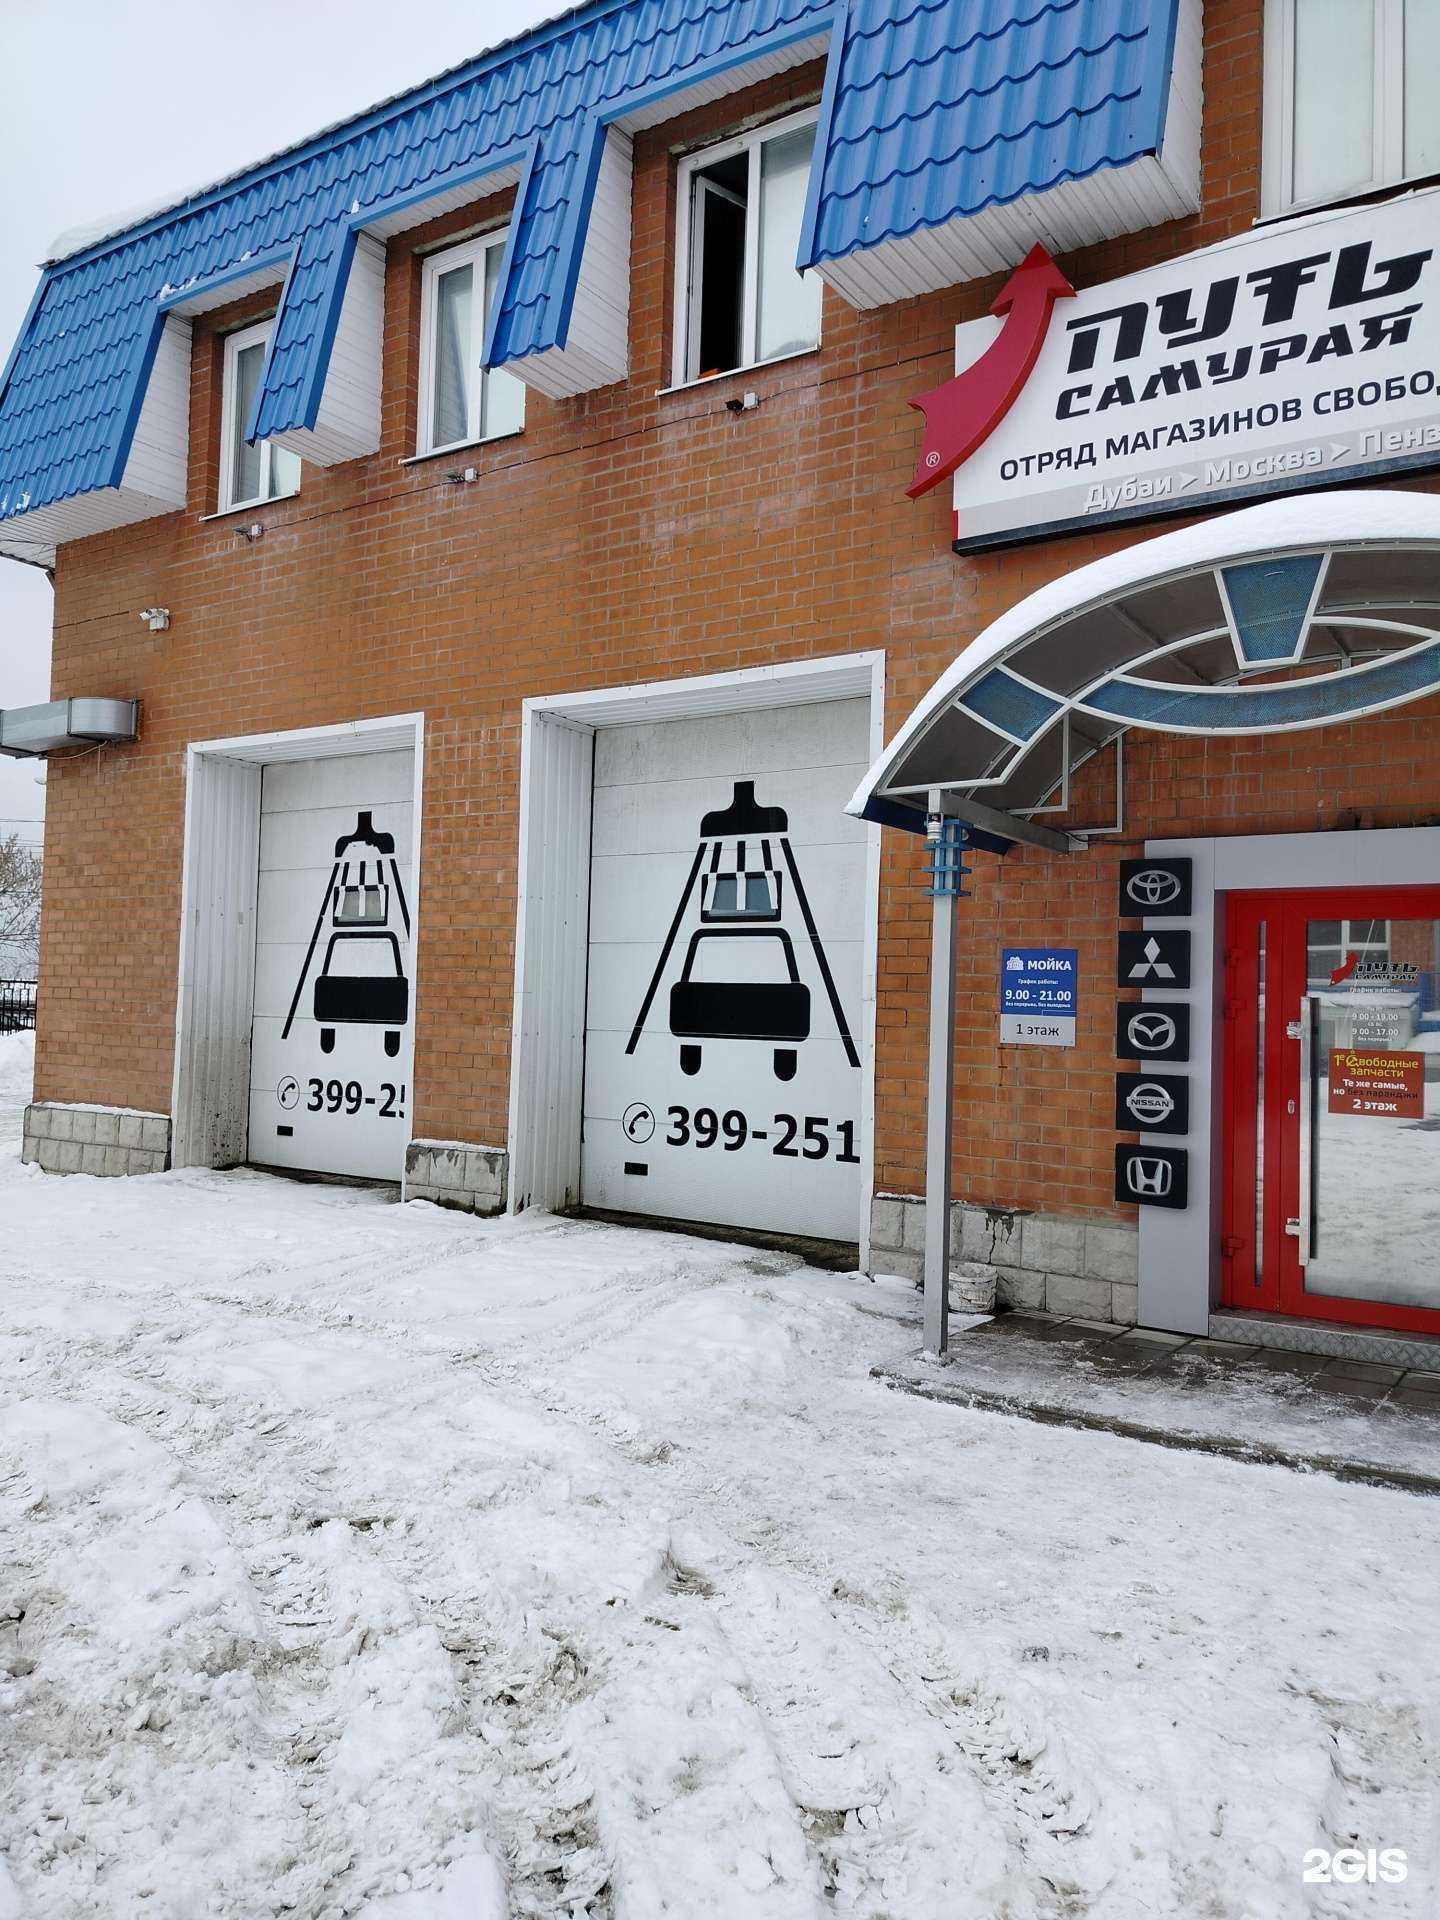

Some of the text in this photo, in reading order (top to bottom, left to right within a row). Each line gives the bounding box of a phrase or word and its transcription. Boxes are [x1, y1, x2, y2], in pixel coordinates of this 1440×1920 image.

[1066, 240, 1433, 375] ПУТЬ
[1055, 302, 1423, 421] САМУРАЯ
[1000, 370, 1440, 481] ОТРЯД МАГАЗИНОВ СВОБО
[1205, 446, 1323, 486] Москва
[1027, 958, 1072, 971] МОЙКА
[1005, 989, 1030, 1000] 9.00
[1039, 990, 1072, 1001] 21.00
[1016, 1023, 1060, 1037] 1 этаж
[1350, 1068, 1404, 1078] запчасти
[1342, 1078, 1409, 1092] Те же самые,
[1130, 1098, 1169, 1108] NISSAN
[1352, 1098, 1398, 1111] 2 этаж
[666, 1105, 861, 1164] 399-251
